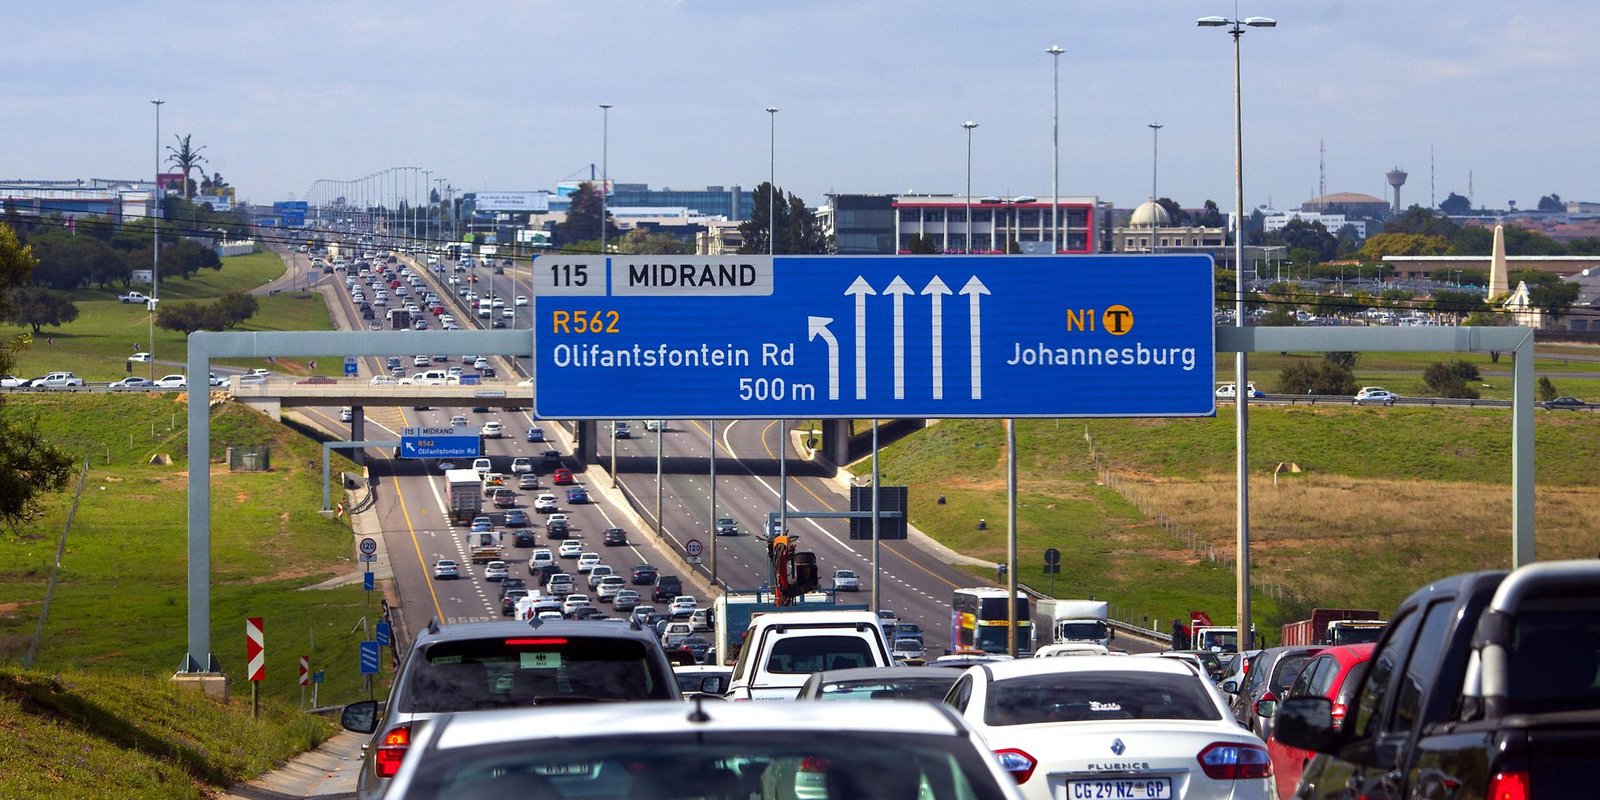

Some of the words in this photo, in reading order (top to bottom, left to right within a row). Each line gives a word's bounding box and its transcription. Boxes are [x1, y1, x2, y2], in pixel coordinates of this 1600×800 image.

[551, 264, 588, 287] 115
[629, 264, 756, 287] MIDRAND
[553, 311, 620, 334] R562
[1066, 309, 1095, 332] N1
[1107, 310, 1129, 333] T
[553, 343, 749, 367] Olifantsfontein
[762, 343, 794, 367] Rd
[1007, 342, 1195, 371] Johannesburg
[739, 378, 785, 401] 500
[792, 383, 815, 401] m
[362, 542, 375, 550] 120
[688, 544, 701, 552] 120
[1087, 762, 1150, 770] FLUENCE
[1074, 782, 1092, 799] CG
[1095, 781, 1112, 799] 29
[1116, 781, 1134, 798] NZ
[1146, 780, 1163, 798] GP
